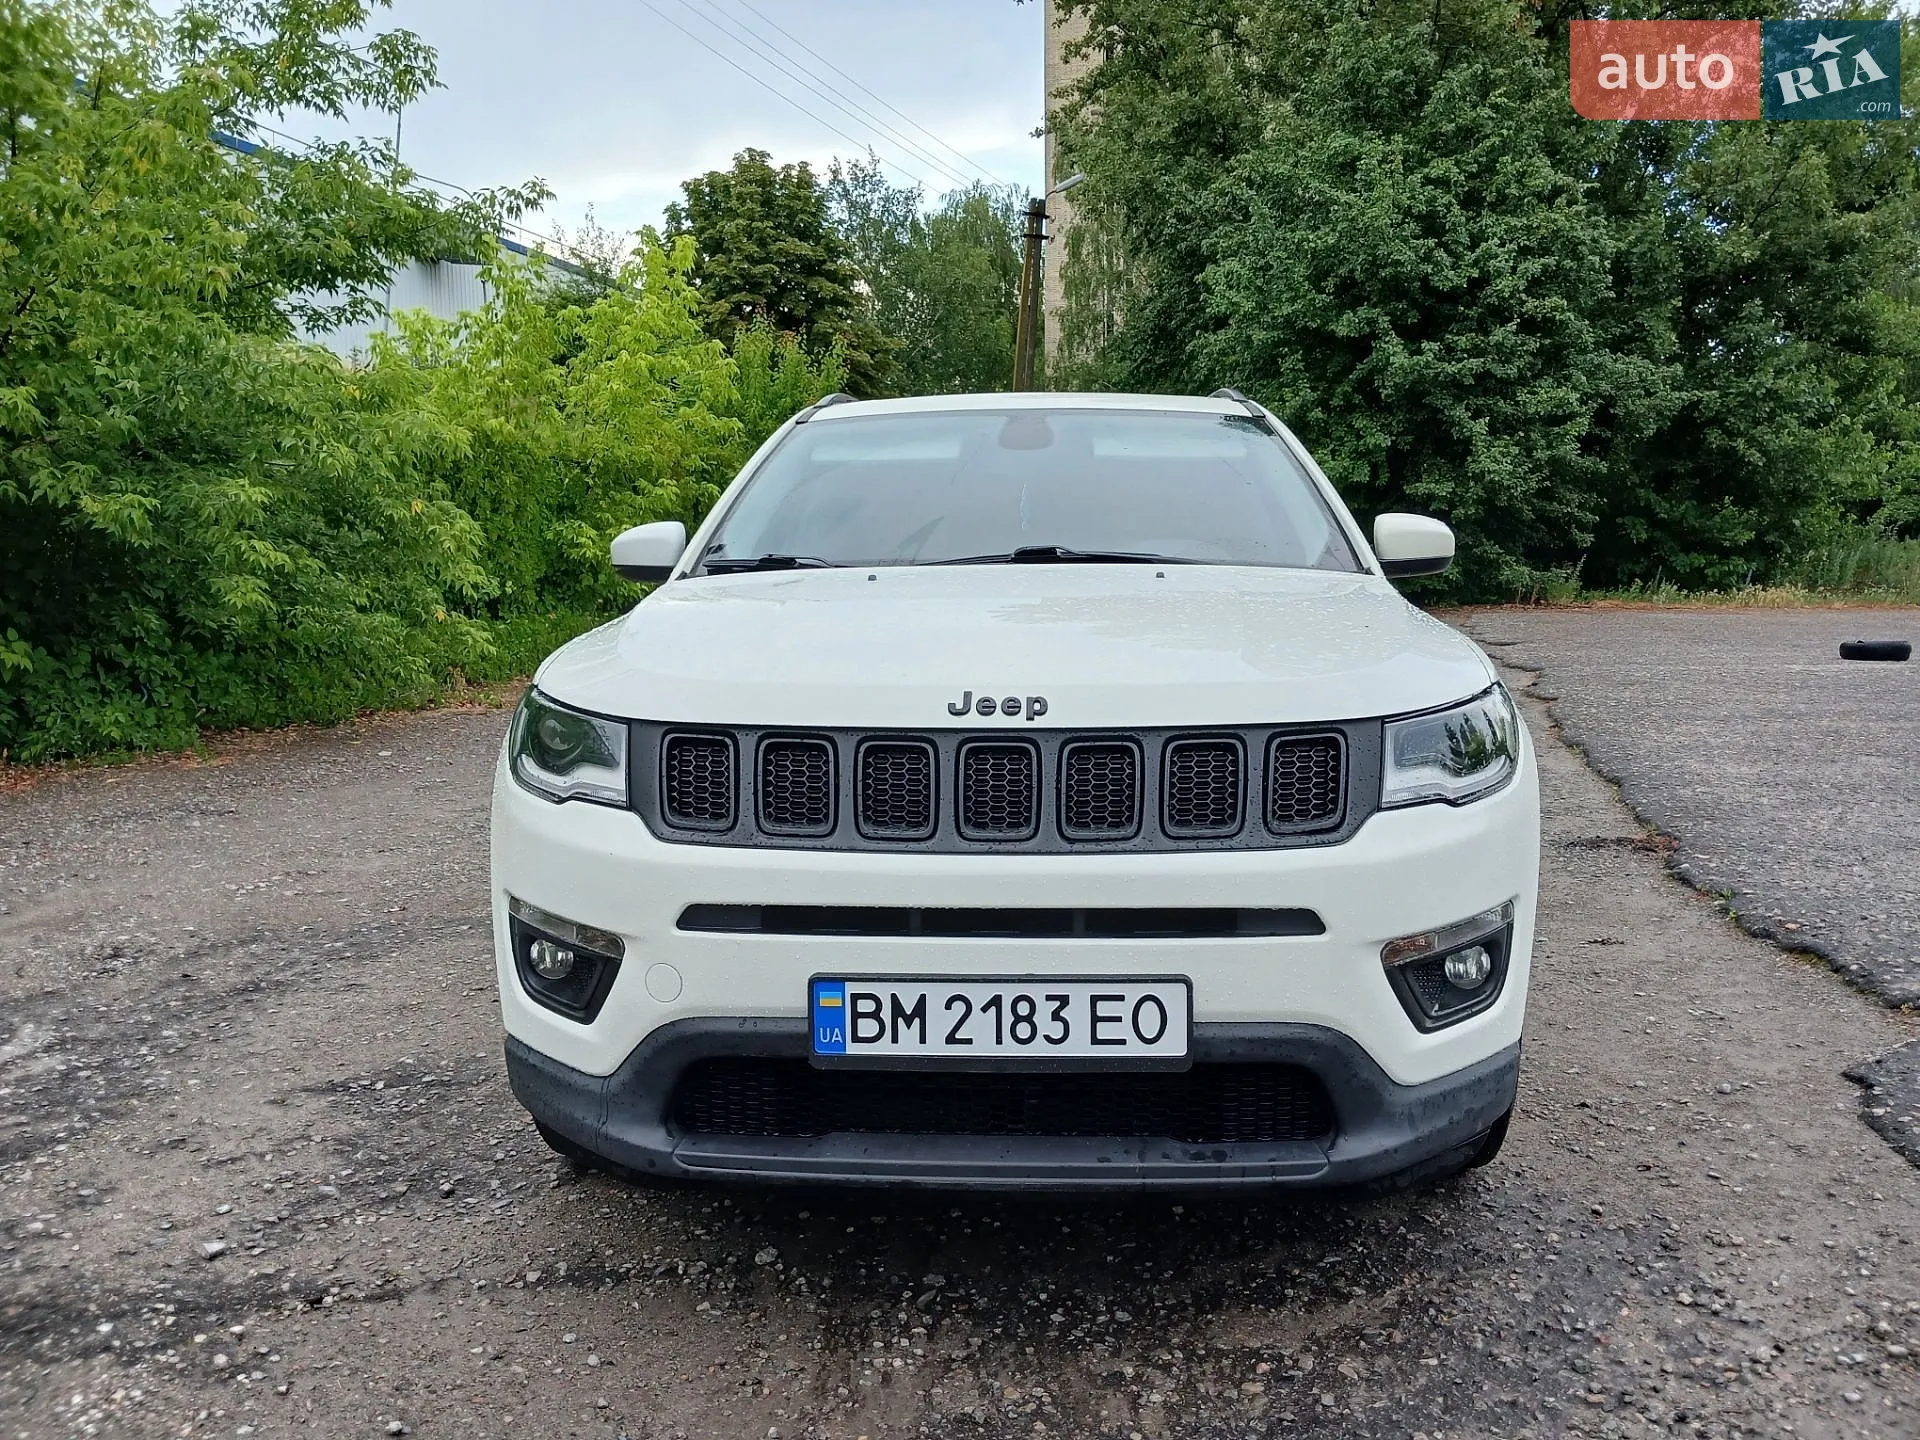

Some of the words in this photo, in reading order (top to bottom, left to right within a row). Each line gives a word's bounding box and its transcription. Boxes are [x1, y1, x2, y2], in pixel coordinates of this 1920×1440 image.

[947, 691, 1048, 721] Jeep
[849, 992, 927, 1045] BM
[944, 993, 1070, 1046] 2183
[1090, 993, 1168, 1046] EO
[819, 1027, 843, 1043] UA
